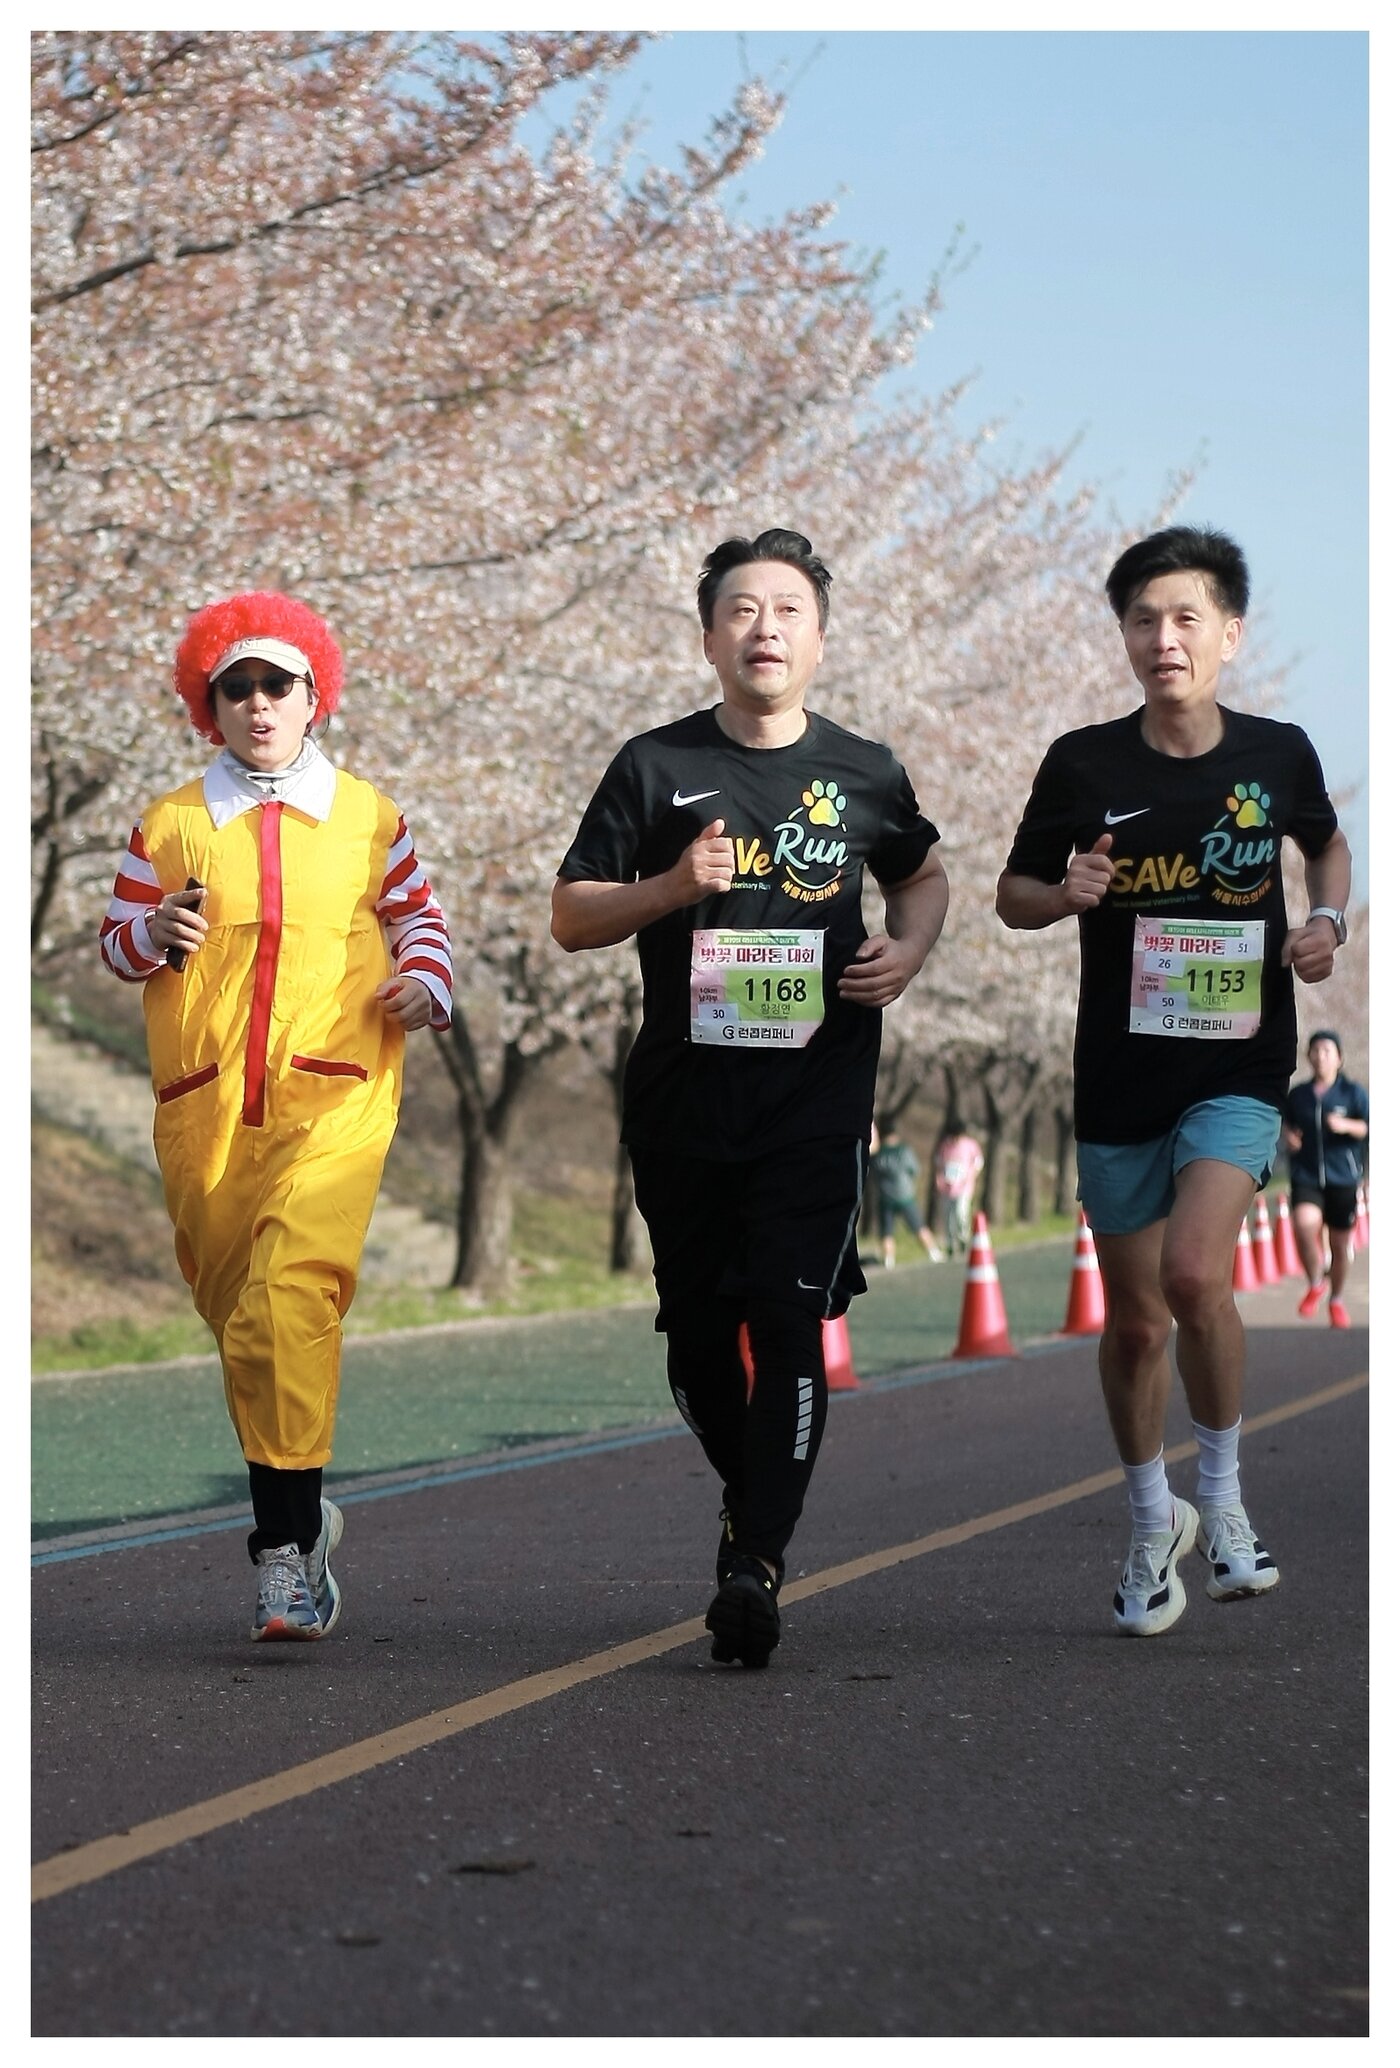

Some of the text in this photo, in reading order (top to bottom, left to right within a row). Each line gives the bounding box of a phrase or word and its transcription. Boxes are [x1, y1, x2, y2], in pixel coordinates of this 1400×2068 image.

[773, 822, 848, 870] Run
[1200, 831, 1276, 876] Run
[1110, 853, 1200, 894] SAVe
[700, 948, 815, 963] 벚꽃 마라톤 대회
[1144, 936, 1225, 956] 벚꽃 마라톤
[1237, 943, 1249, 953] 51
[1158, 959, 1171, 969] 26
[744, 978, 807, 1003] 1168
[1187, 968, 1246, 993] 1153
[1162, 997, 1175, 1007] 50
[712, 1009, 725, 1019] 30
